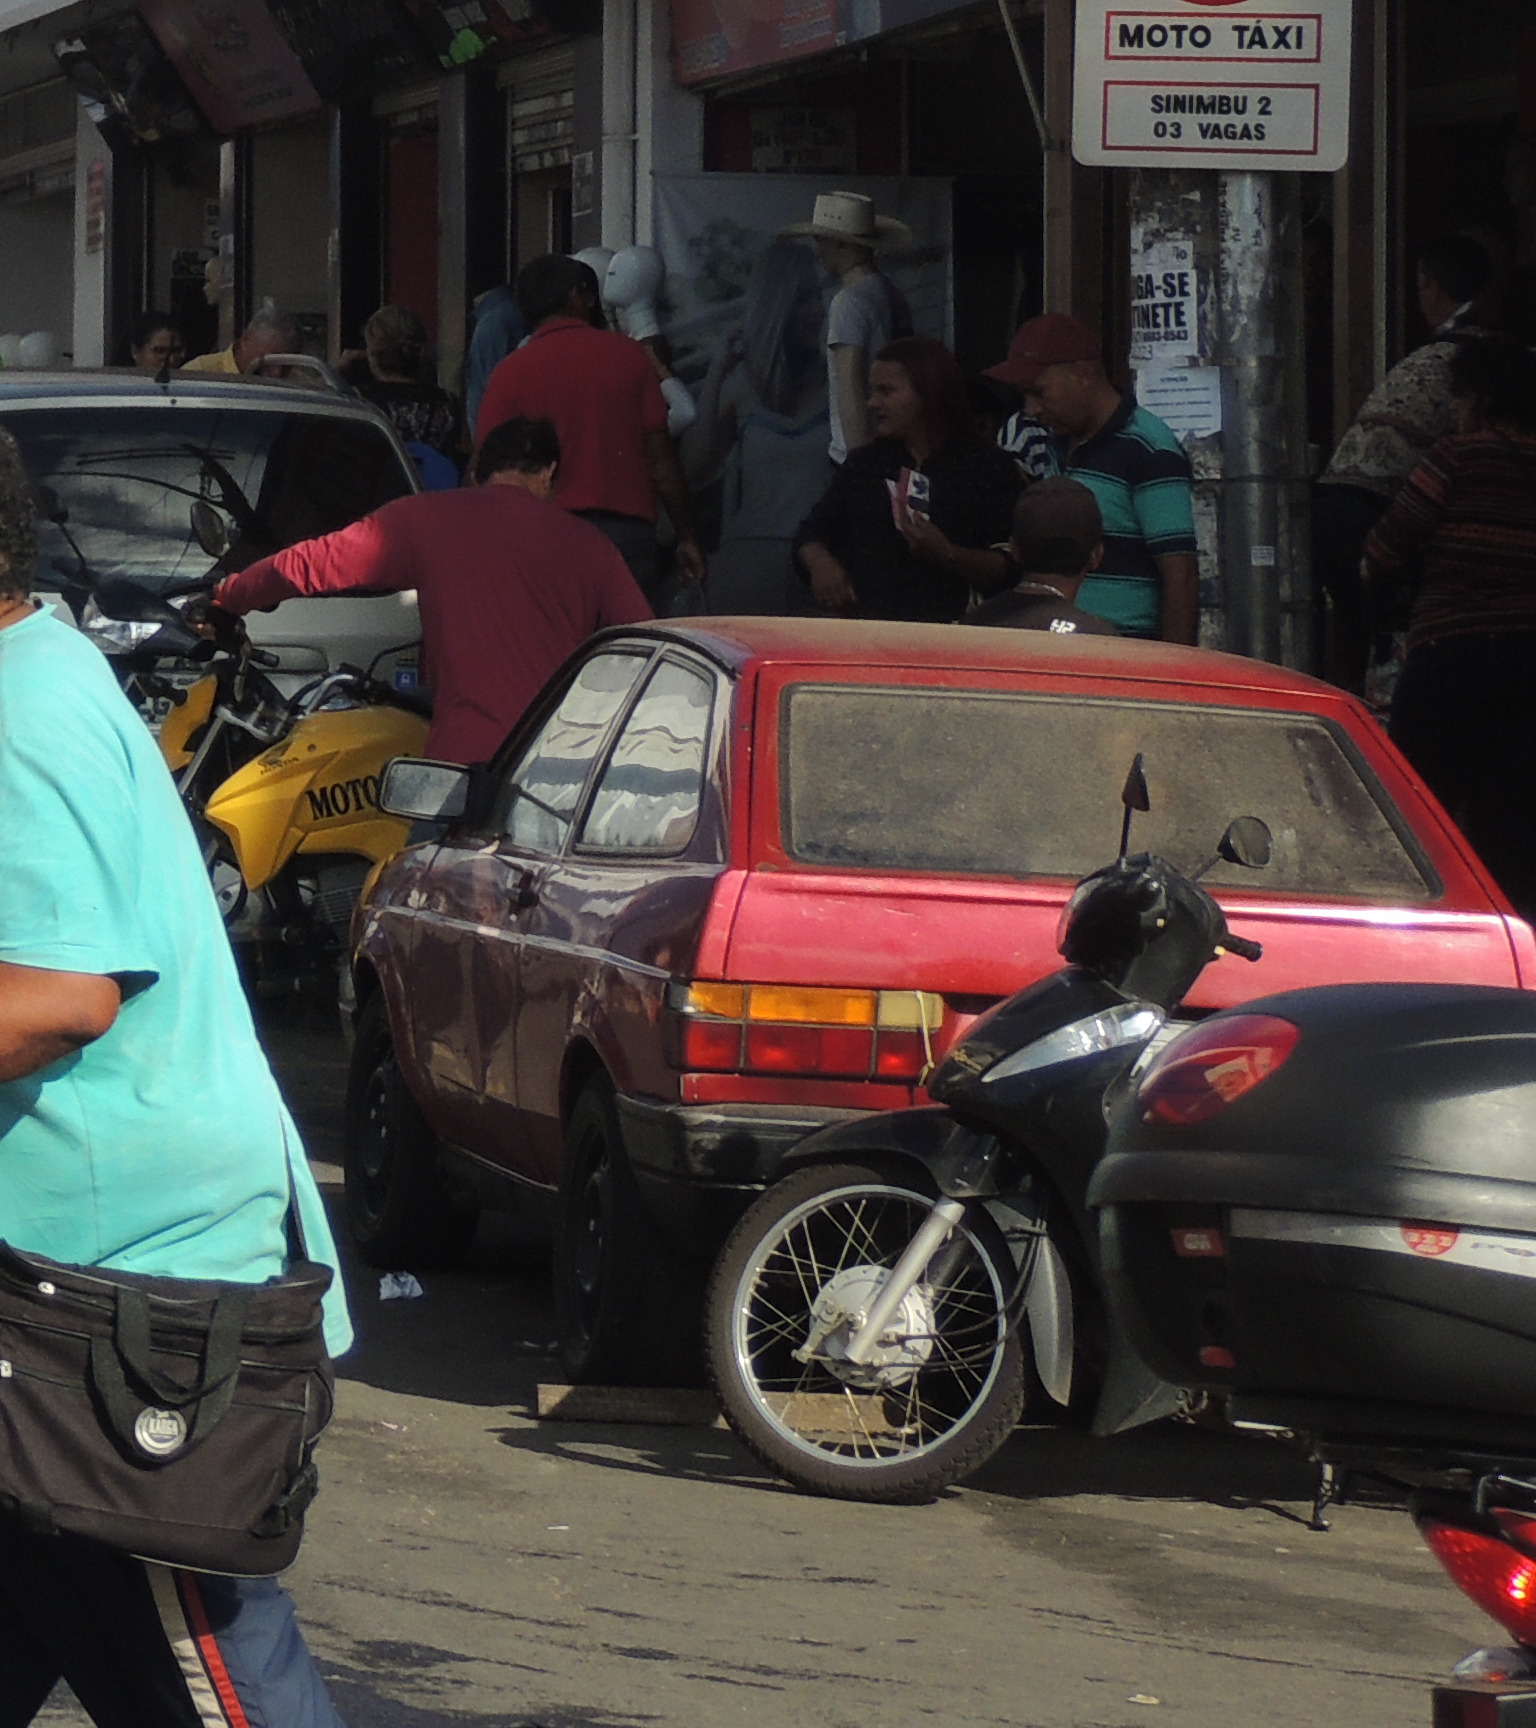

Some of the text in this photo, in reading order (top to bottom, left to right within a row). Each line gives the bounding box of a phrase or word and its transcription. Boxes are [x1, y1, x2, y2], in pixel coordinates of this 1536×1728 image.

[1118, 20, 1304, 50] MOTO TÁXI
[1150, 94, 1273, 116] SINIMBU 2
[1153, 121, 1266, 141] 03 VAGAS
[305, 775, 380, 821] MOTO
